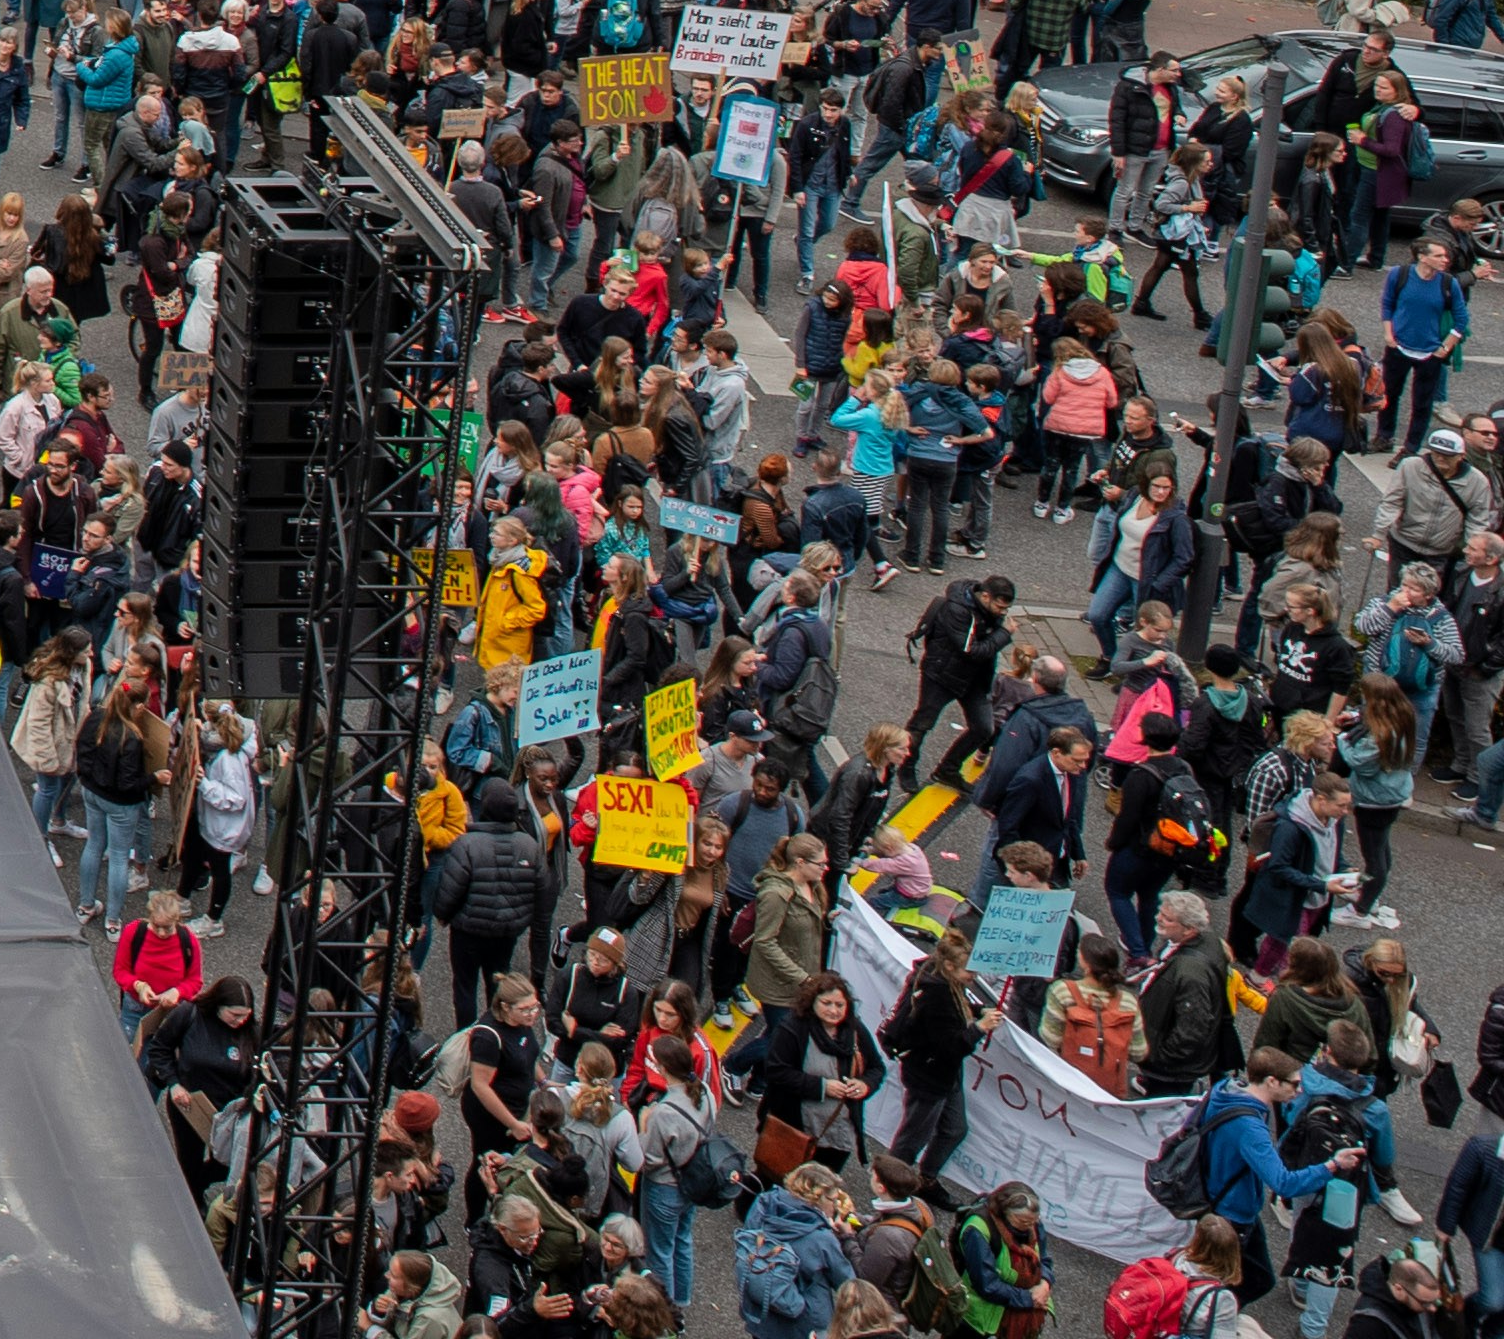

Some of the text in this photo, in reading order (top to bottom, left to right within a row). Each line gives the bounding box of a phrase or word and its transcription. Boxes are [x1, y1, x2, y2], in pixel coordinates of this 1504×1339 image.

[687, 10, 778, 31] Man sieht den
[681, 26, 778, 49] Wald vor lauter
[674, 46, 768, 67] Bränden nicht.
[582, 56, 669, 89] THE HEAT
[733, 104, 763, 119] There
[993, 888, 1044, 906] PFLANZEN
